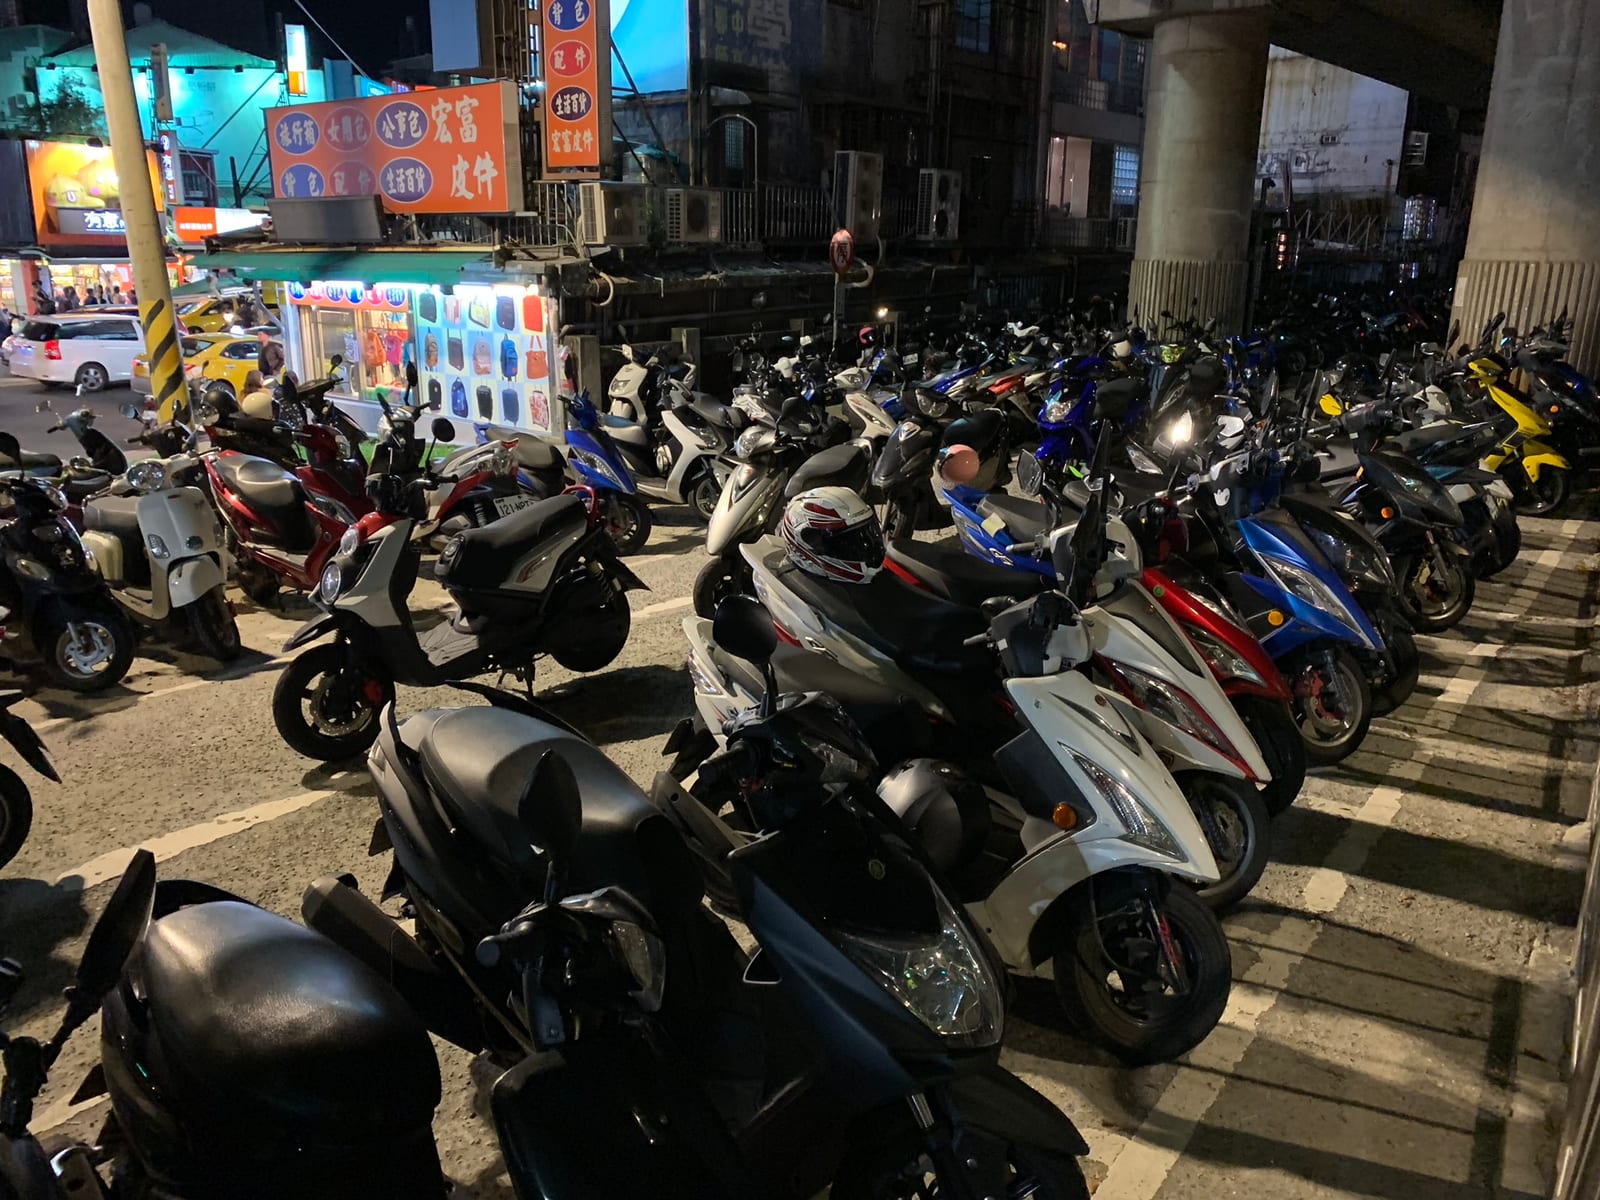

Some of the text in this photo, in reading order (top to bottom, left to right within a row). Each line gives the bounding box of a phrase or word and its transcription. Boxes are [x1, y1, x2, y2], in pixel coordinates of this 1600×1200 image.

[552, 0, 585, 25] 背包
[554, 46, 586, 70] 配件
[555, 91, 587, 115] 生活百貨
[280, 119, 316, 147] 旅行箱
[327, 114, 368, 144] 女用包
[382, 110, 422, 139] 公事包
[431, 95, 479, 144] 宏富
[552, 128, 594, 153] 宏富皮件
[386, 166, 426, 195] 生活百貨
[450, 151, 498, 201] 皮件
